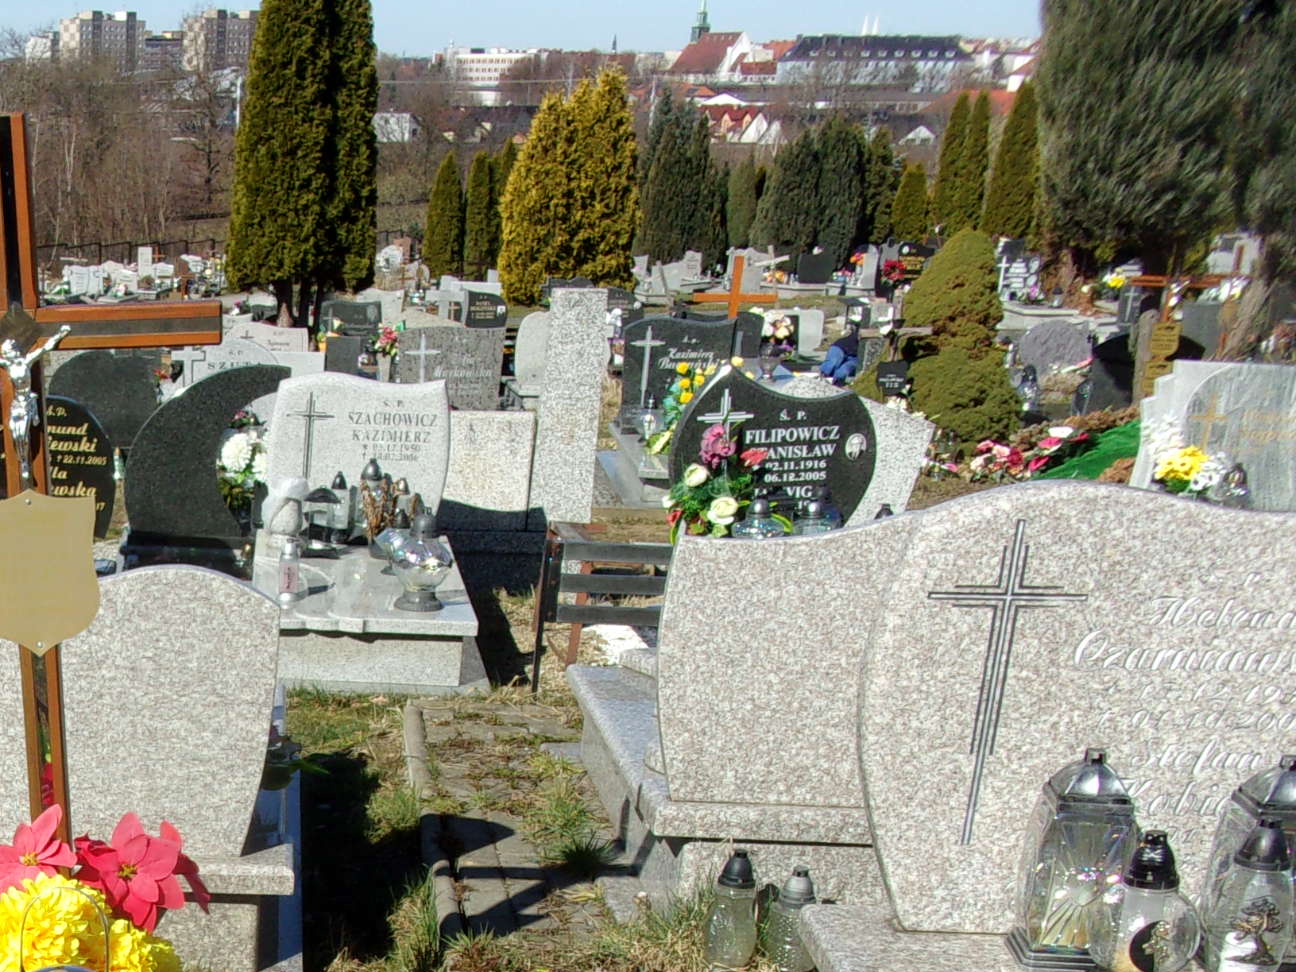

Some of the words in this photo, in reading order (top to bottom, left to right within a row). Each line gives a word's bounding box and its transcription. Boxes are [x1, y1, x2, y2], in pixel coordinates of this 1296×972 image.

[348, 411, 438, 427] SZACHOWICZ
[352, 429, 432, 443] KAZIMIERZ
[745, 425, 841, 445] FILIPOWICZ
[48, 436, 98, 453] iewski
[750, 443, 836, 460] ANISŁAW
